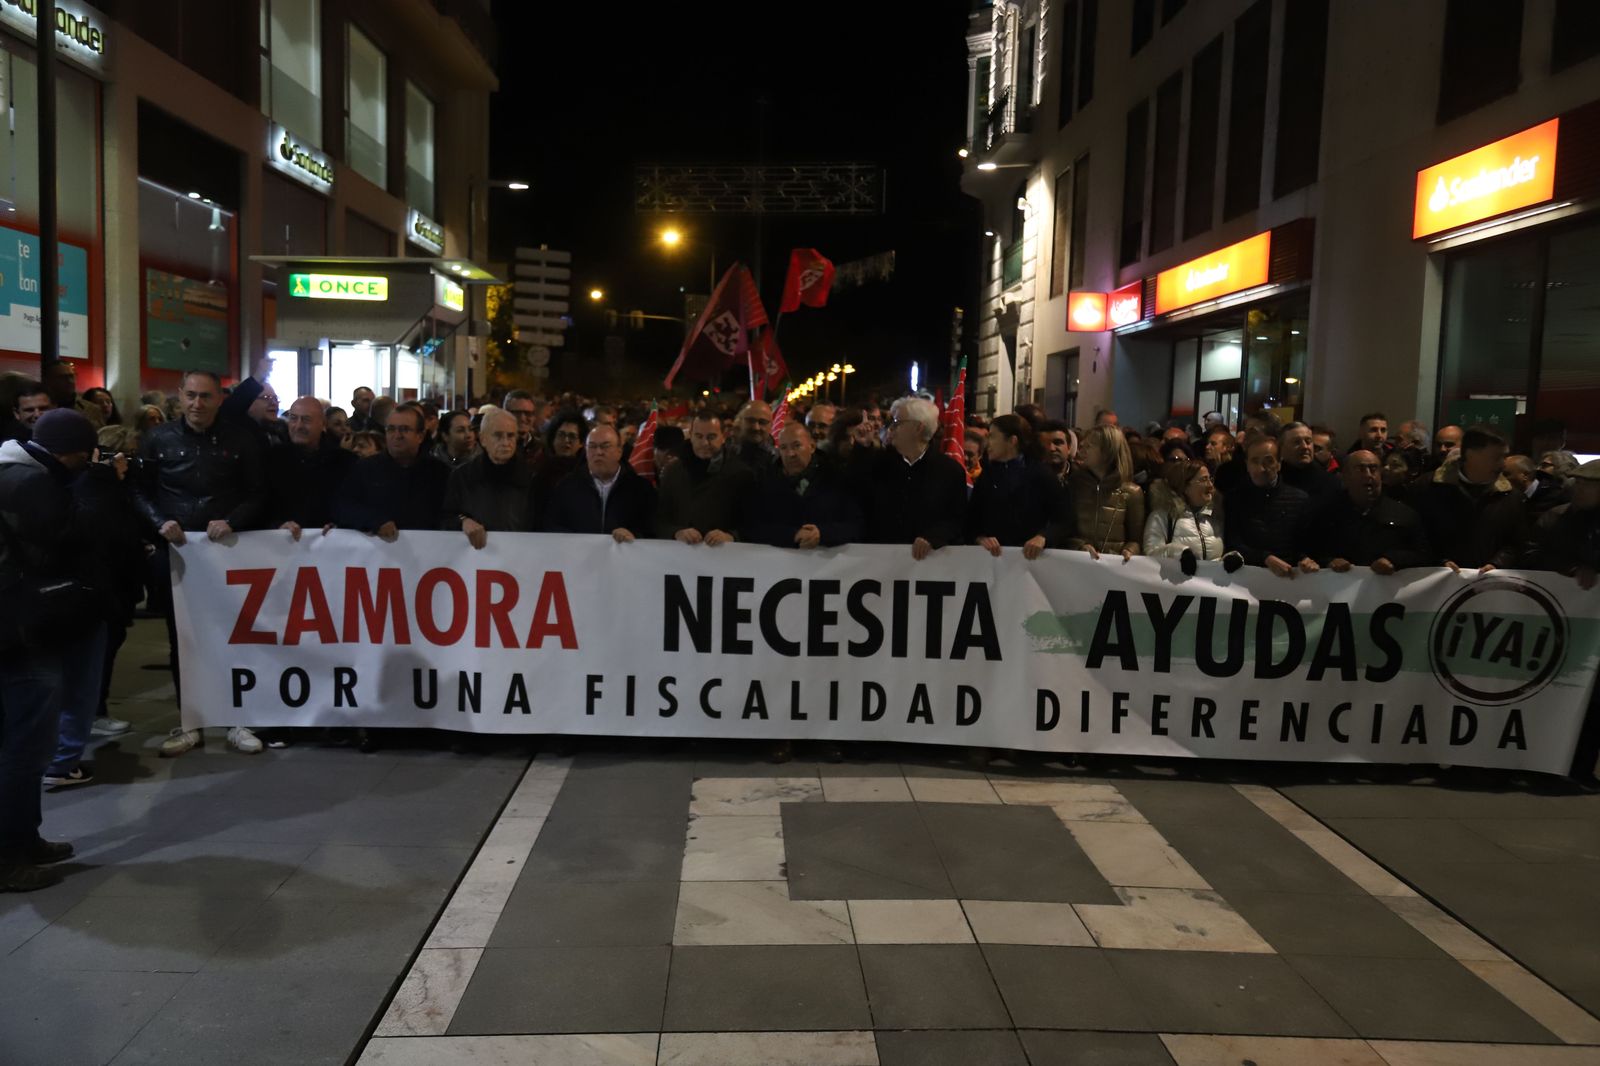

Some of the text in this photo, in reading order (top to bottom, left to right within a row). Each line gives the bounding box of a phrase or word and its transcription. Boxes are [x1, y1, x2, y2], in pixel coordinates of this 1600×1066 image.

[1450, 155, 1540, 207] Santander
[319, 280, 379, 295] ONCE
[225, 566, 1406, 683] ZAMORA NECESITA AYUDAS
[1446, 612, 1551, 672] ¡YA!
[231, 666, 1528, 751] POR UNA FISCALIDAD DIFERENCIADA
